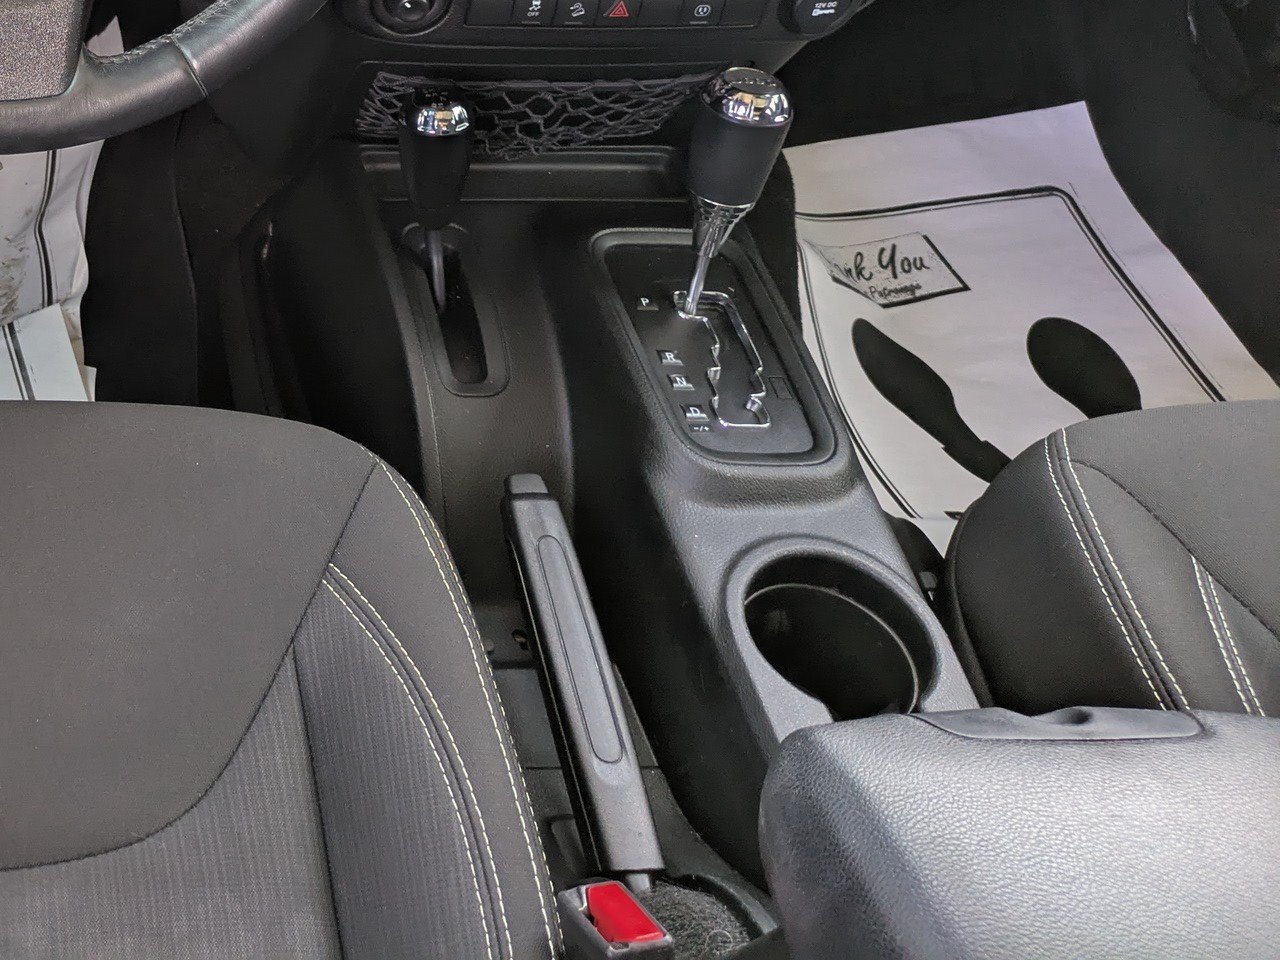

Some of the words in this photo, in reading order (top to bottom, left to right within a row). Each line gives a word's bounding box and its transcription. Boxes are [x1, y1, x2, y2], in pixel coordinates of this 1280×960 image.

[878, 243, 930, 280] You
[640, 297, 650, 306] P
[665, 352, 675, 362] R
[675, 376, 687, 386] N
[689, 406, 700, 416] D
